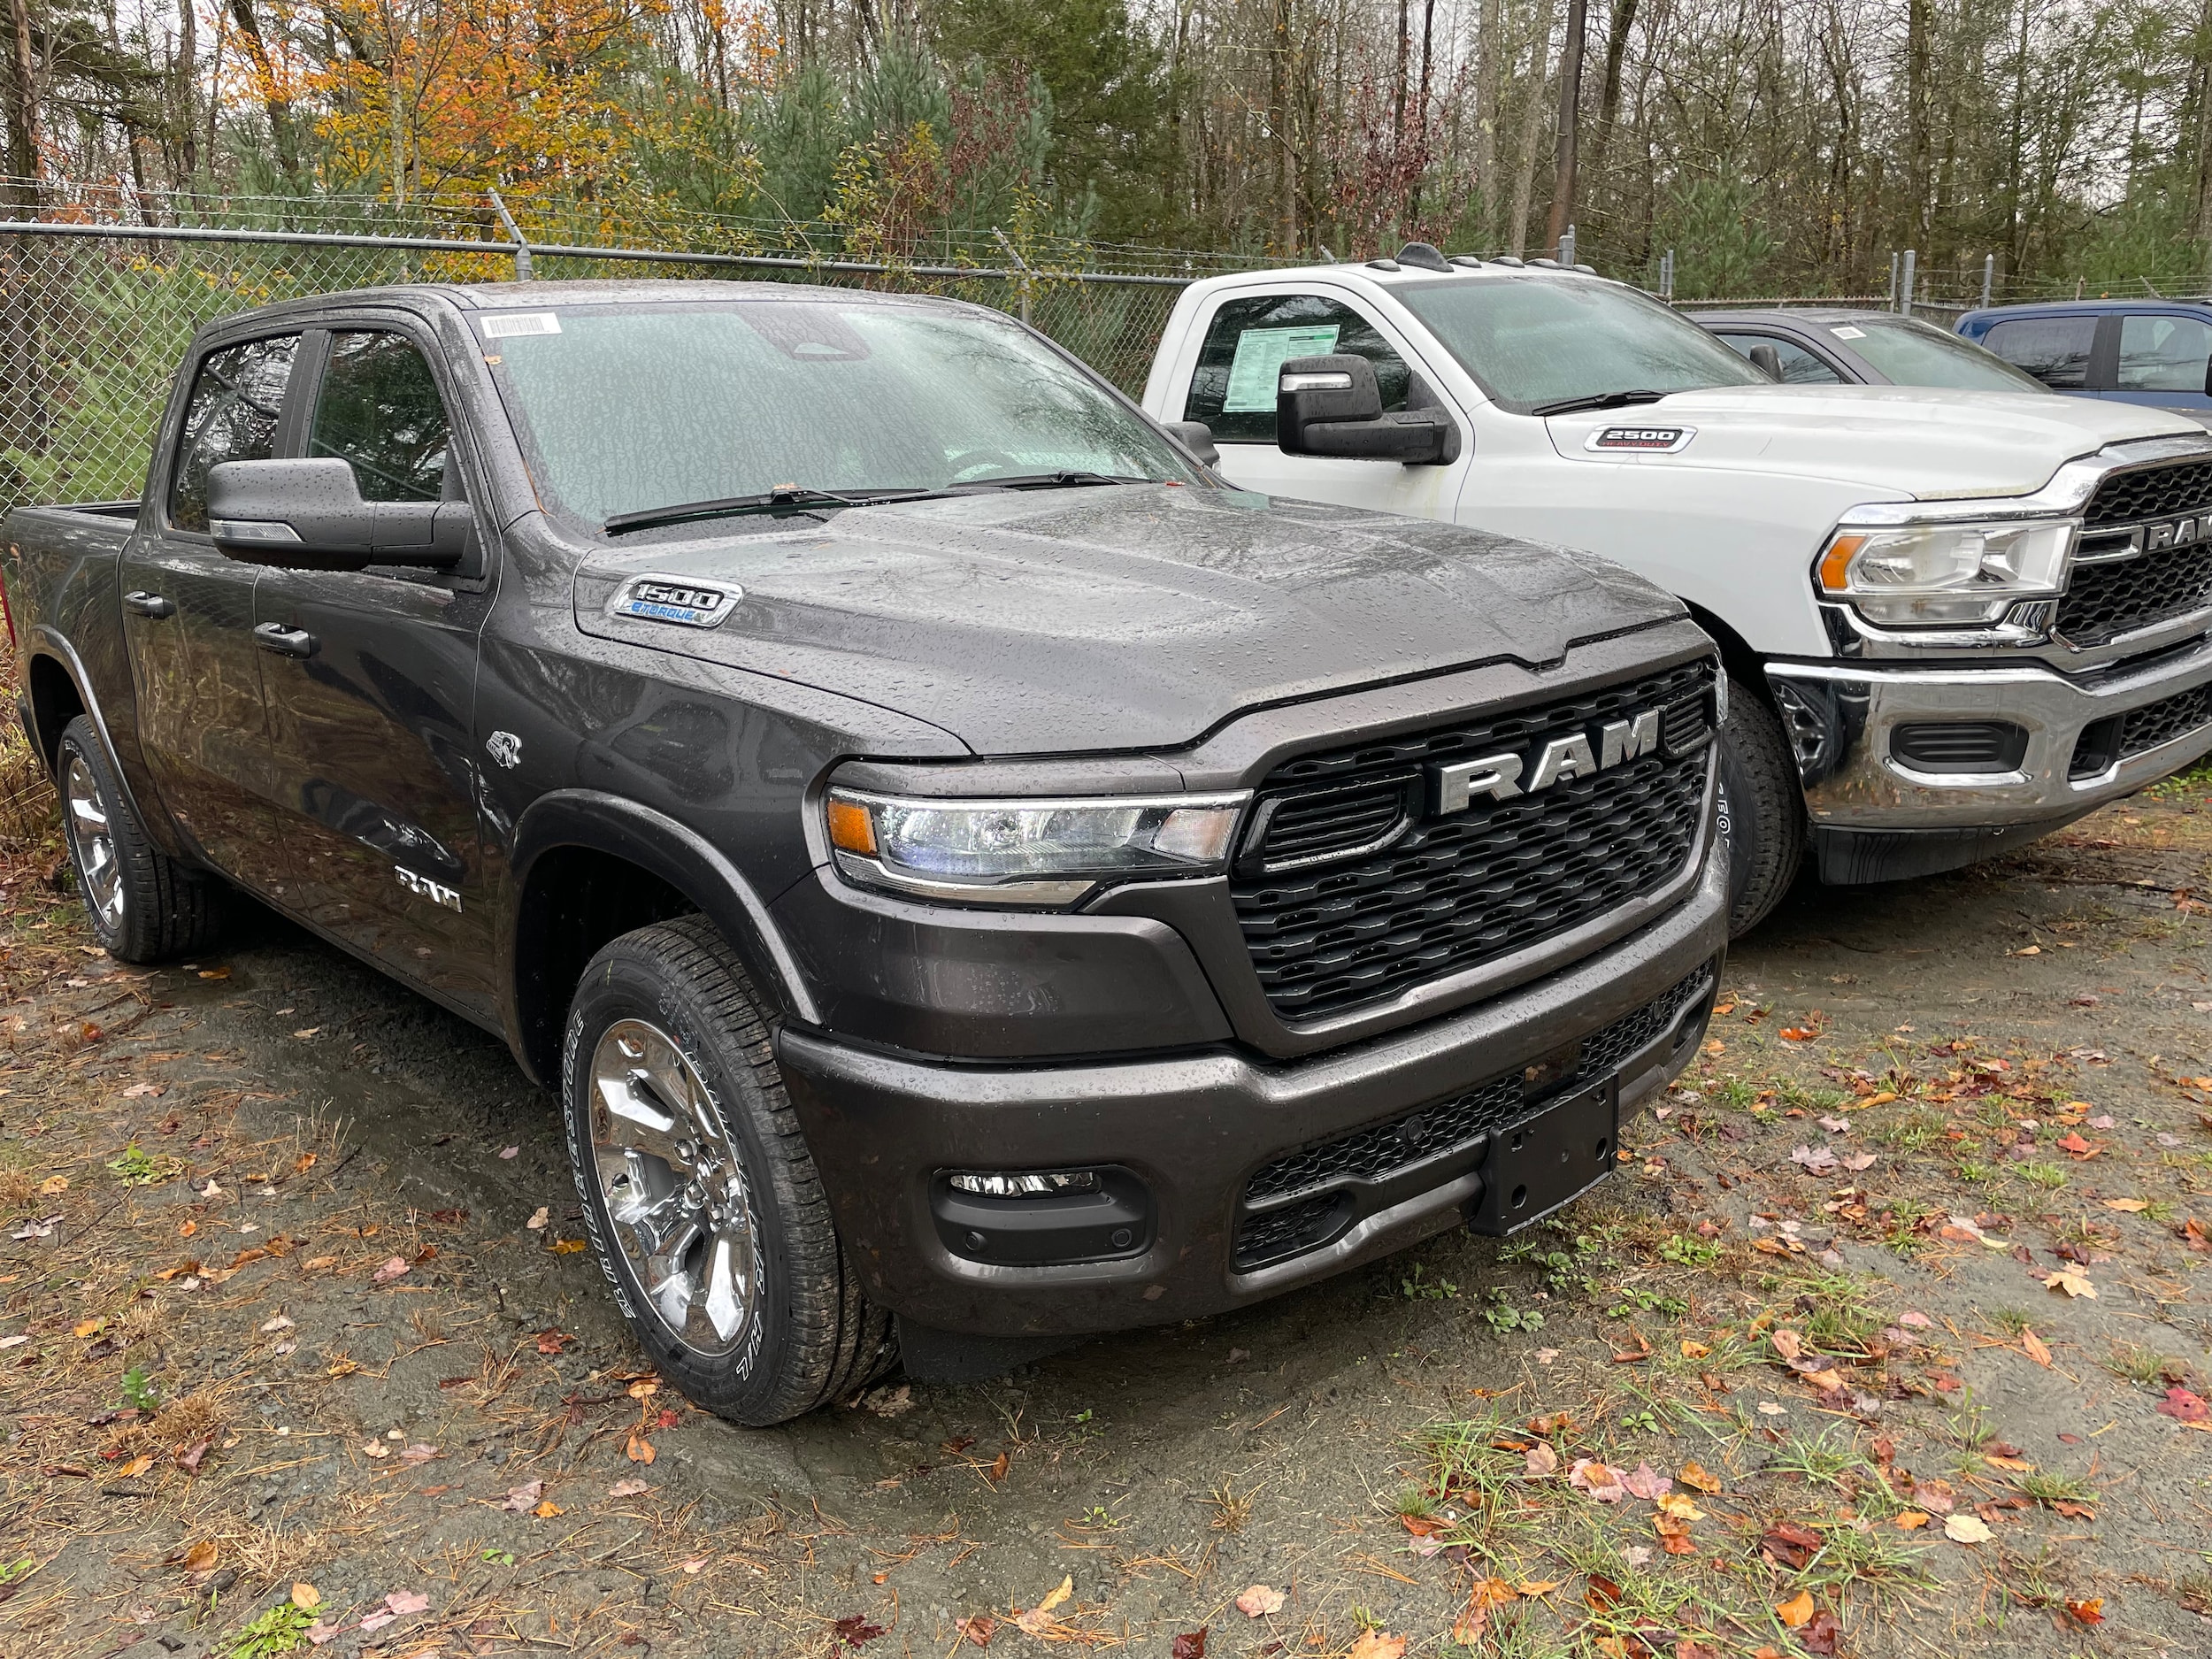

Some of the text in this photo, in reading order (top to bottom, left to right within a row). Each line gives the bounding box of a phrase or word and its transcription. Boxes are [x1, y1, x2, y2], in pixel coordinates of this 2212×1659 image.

[1606, 430, 1675, 441] 2500
[635, 583, 719, 610] 1500
[1440, 708, 1660, 816] RAM
[394, 864, 463, 913] RAM
[562, 1008, 637, 1318] BRIDGESTONE
